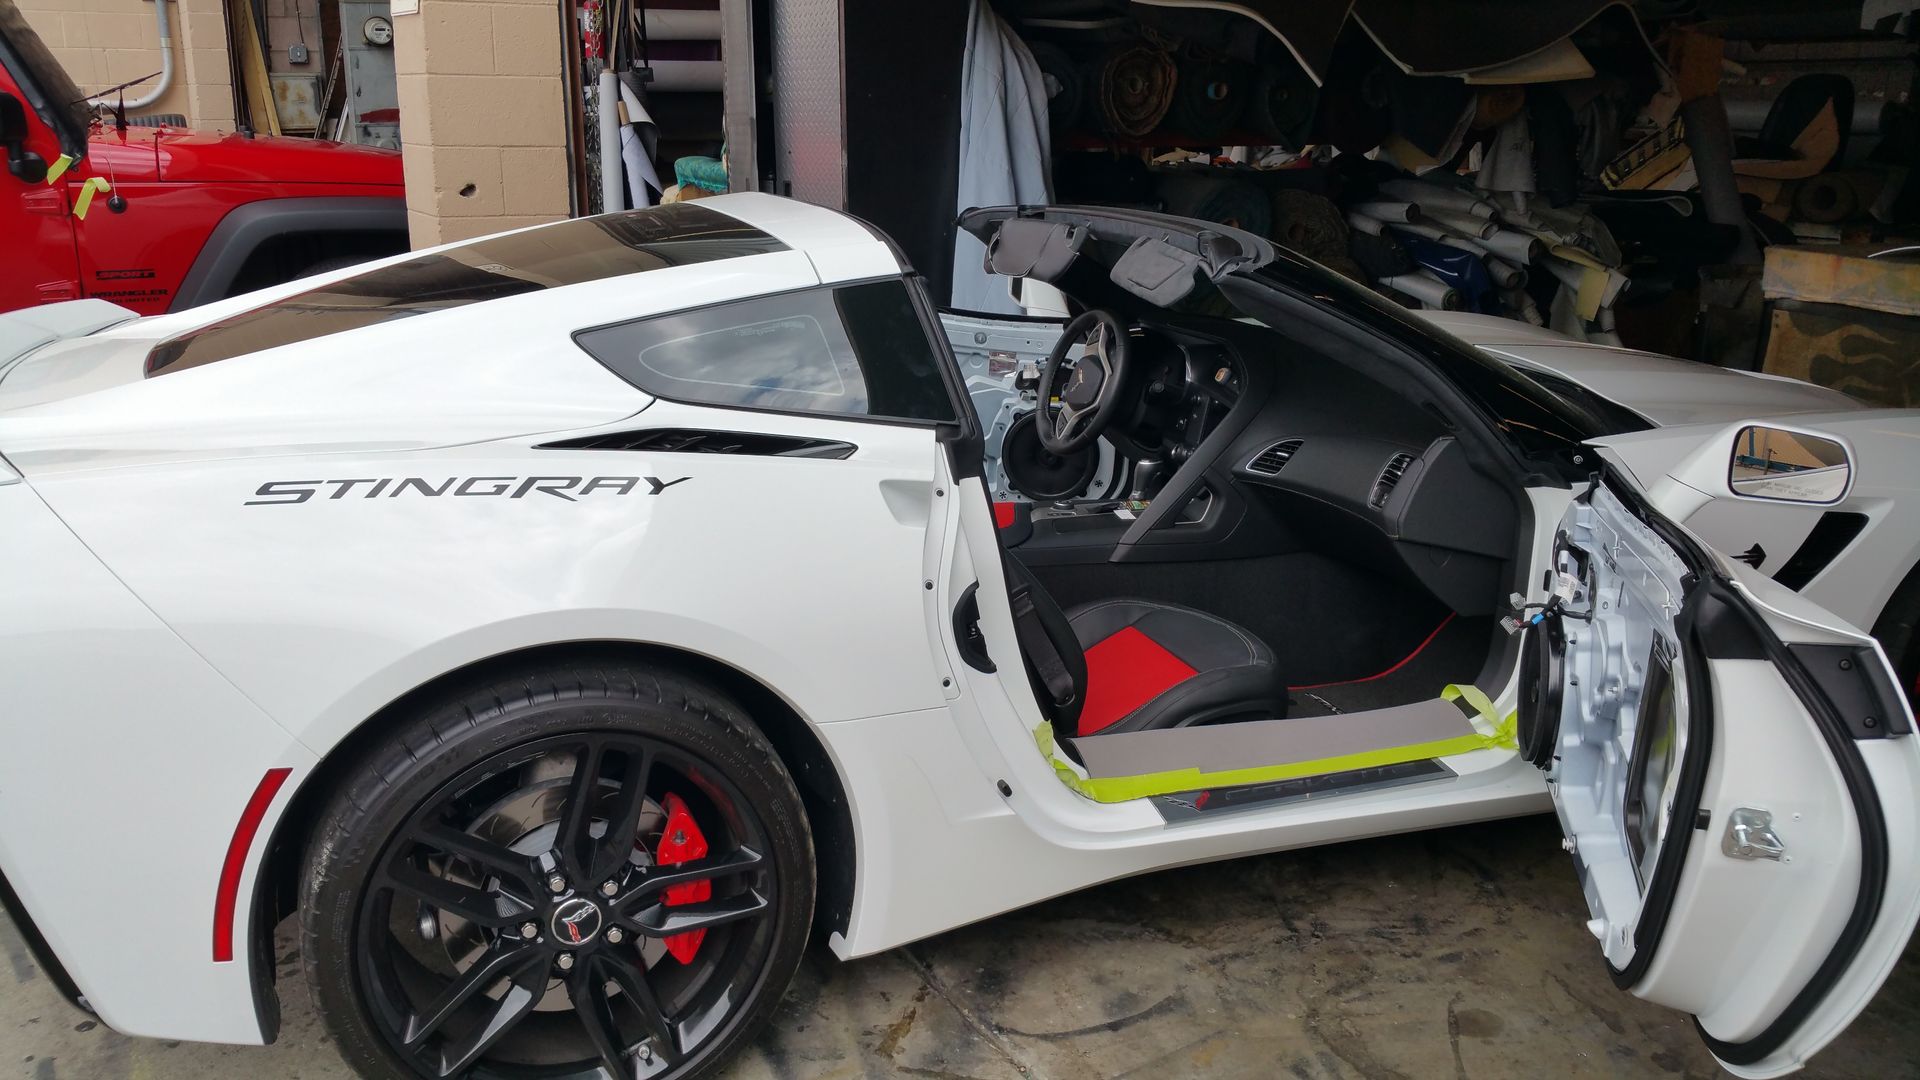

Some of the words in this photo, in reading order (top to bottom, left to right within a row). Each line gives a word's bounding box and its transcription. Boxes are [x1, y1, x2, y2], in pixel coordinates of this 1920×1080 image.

[97, 269, 155, 280] SPORT
[91, 288, 169, 298] WRANGLER
[243, 476, 694, 506] STINGRAY
